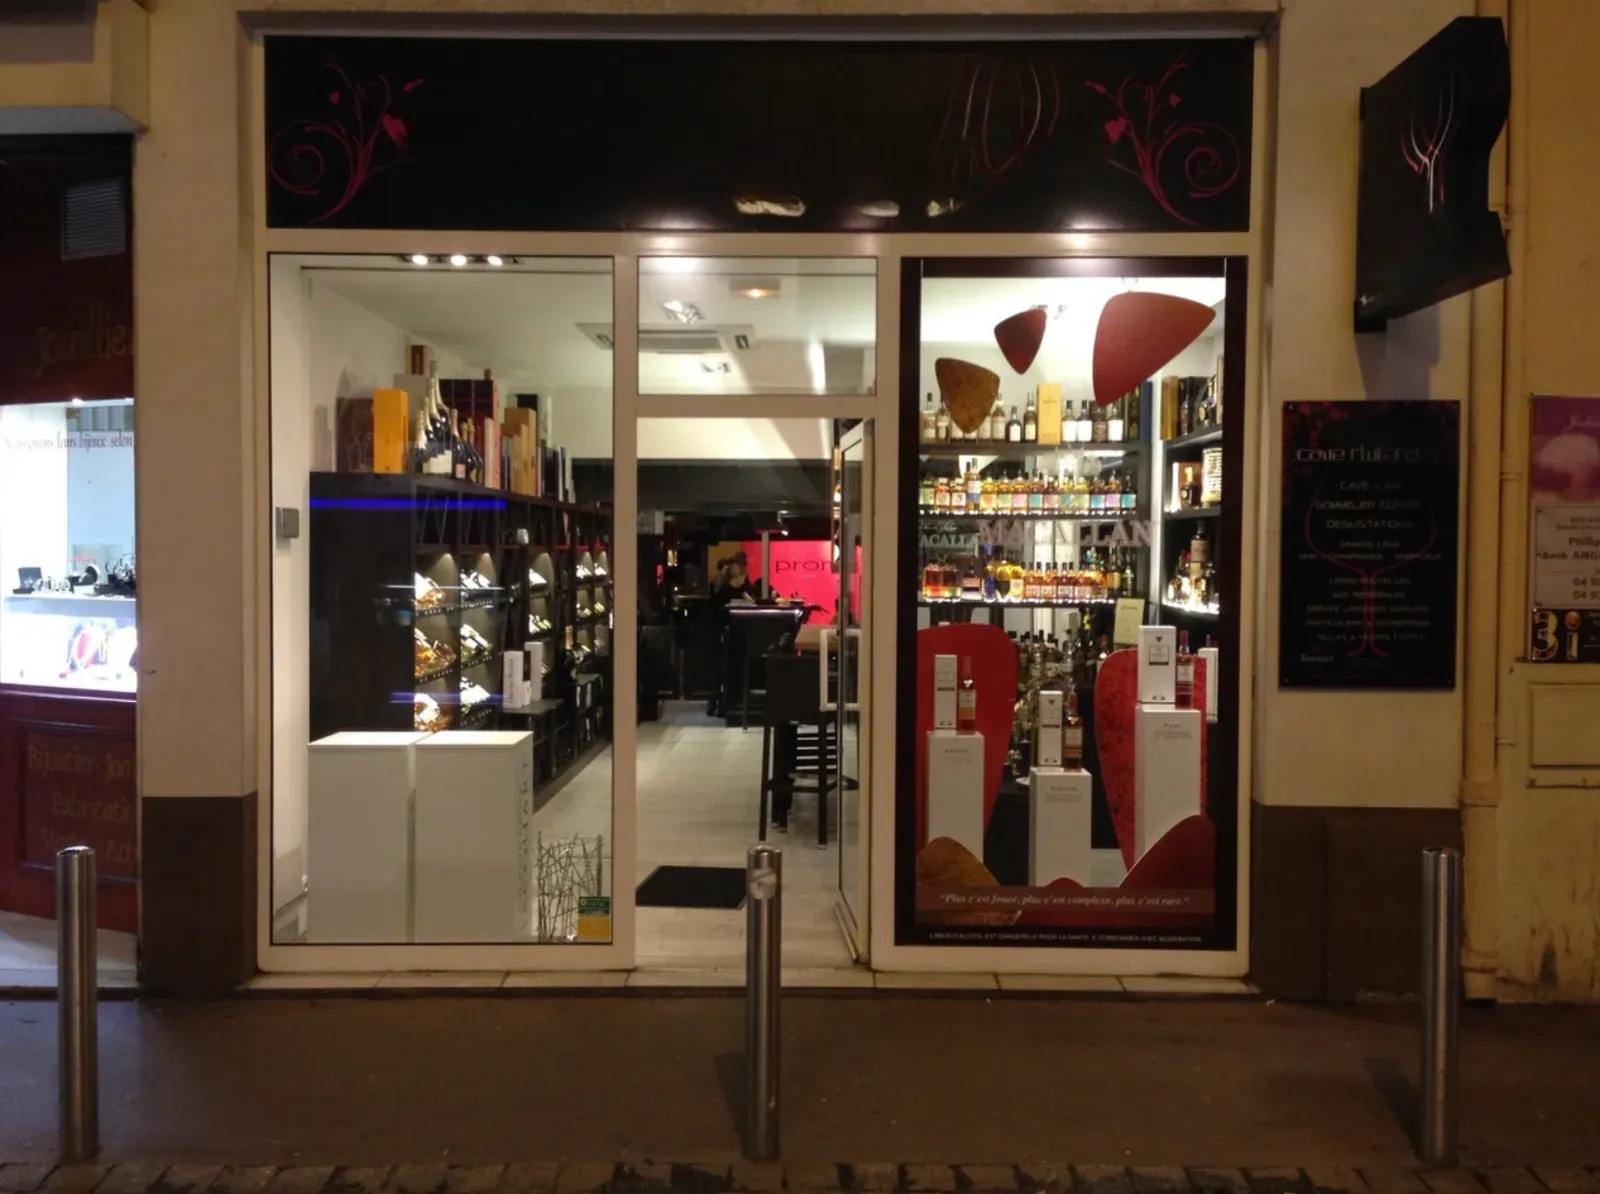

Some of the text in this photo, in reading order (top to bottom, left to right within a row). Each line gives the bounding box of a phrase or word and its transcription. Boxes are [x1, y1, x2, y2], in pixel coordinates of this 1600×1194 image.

[111, 428, 133, 449] selon
[1340, 480, 1369, 491] CAVE
[1022, 894, 1042, 906] plus
[1115, 895, 1135, 908] plus
